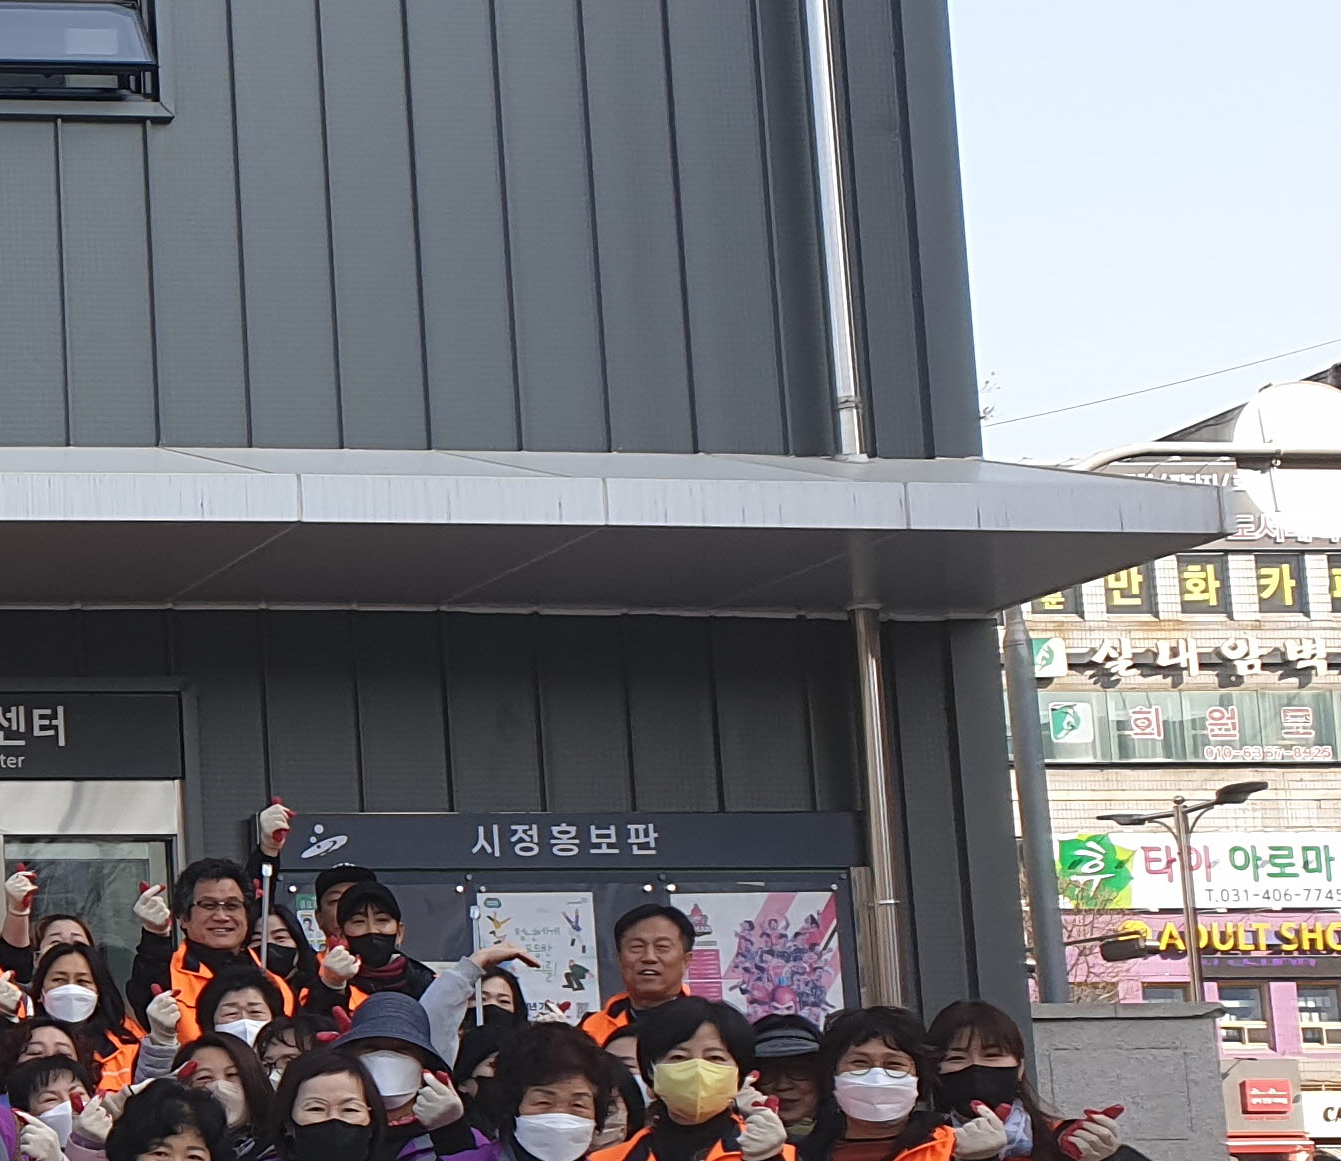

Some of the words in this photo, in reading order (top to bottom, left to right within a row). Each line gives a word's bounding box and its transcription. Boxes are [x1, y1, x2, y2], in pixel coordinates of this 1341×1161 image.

[1092, 636, 1329, 677] 실내암벽
[471, 823, 660, 857] 시정홍보판
[1140, 845, 1212, 883] 타이
[1229, 844, 1336, 883] 아로마
